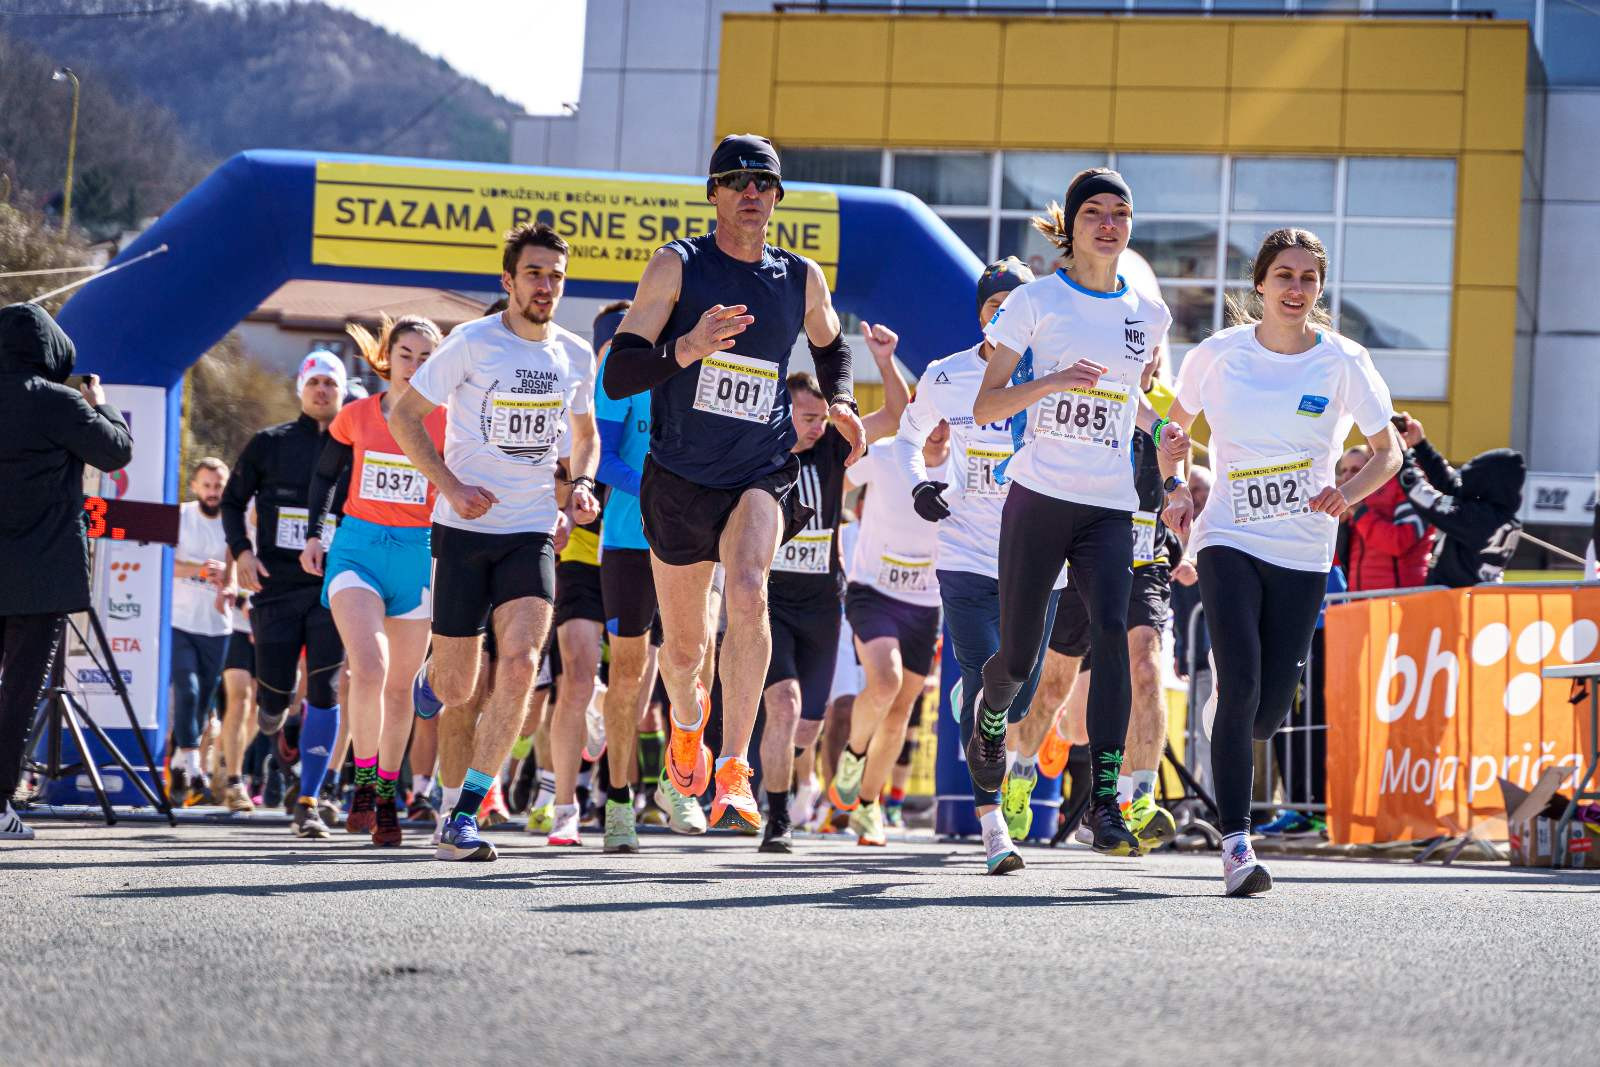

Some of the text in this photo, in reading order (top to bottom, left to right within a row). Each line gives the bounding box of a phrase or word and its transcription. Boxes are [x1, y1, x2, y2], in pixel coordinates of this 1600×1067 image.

[480, 187, 560, 201] UDRUŽENJE
[611, 195, 619, 205] U
[624, 196, 680, 208] PLAVOM
[335, 197, 496, 232] STAZAMA
[1125, 328, 1145, 346] NRC
[515, 369, 559, 382] STAZAMA
[521, 379, 553, 391] BOSNE
[717, 377, 761, 406] 001
[509, 414, 546, 434] 018
[1056, 400, 1107, 430] 085
[376, 472, 413, 492] 037
[1248, 479, 1300, 508] 002
[785, 545, 816, 562] 091
[889, 568, 921, 583] 097
[1376, 627, 1459, 724] bh
[1380, 747, 1459, 806] Moja
